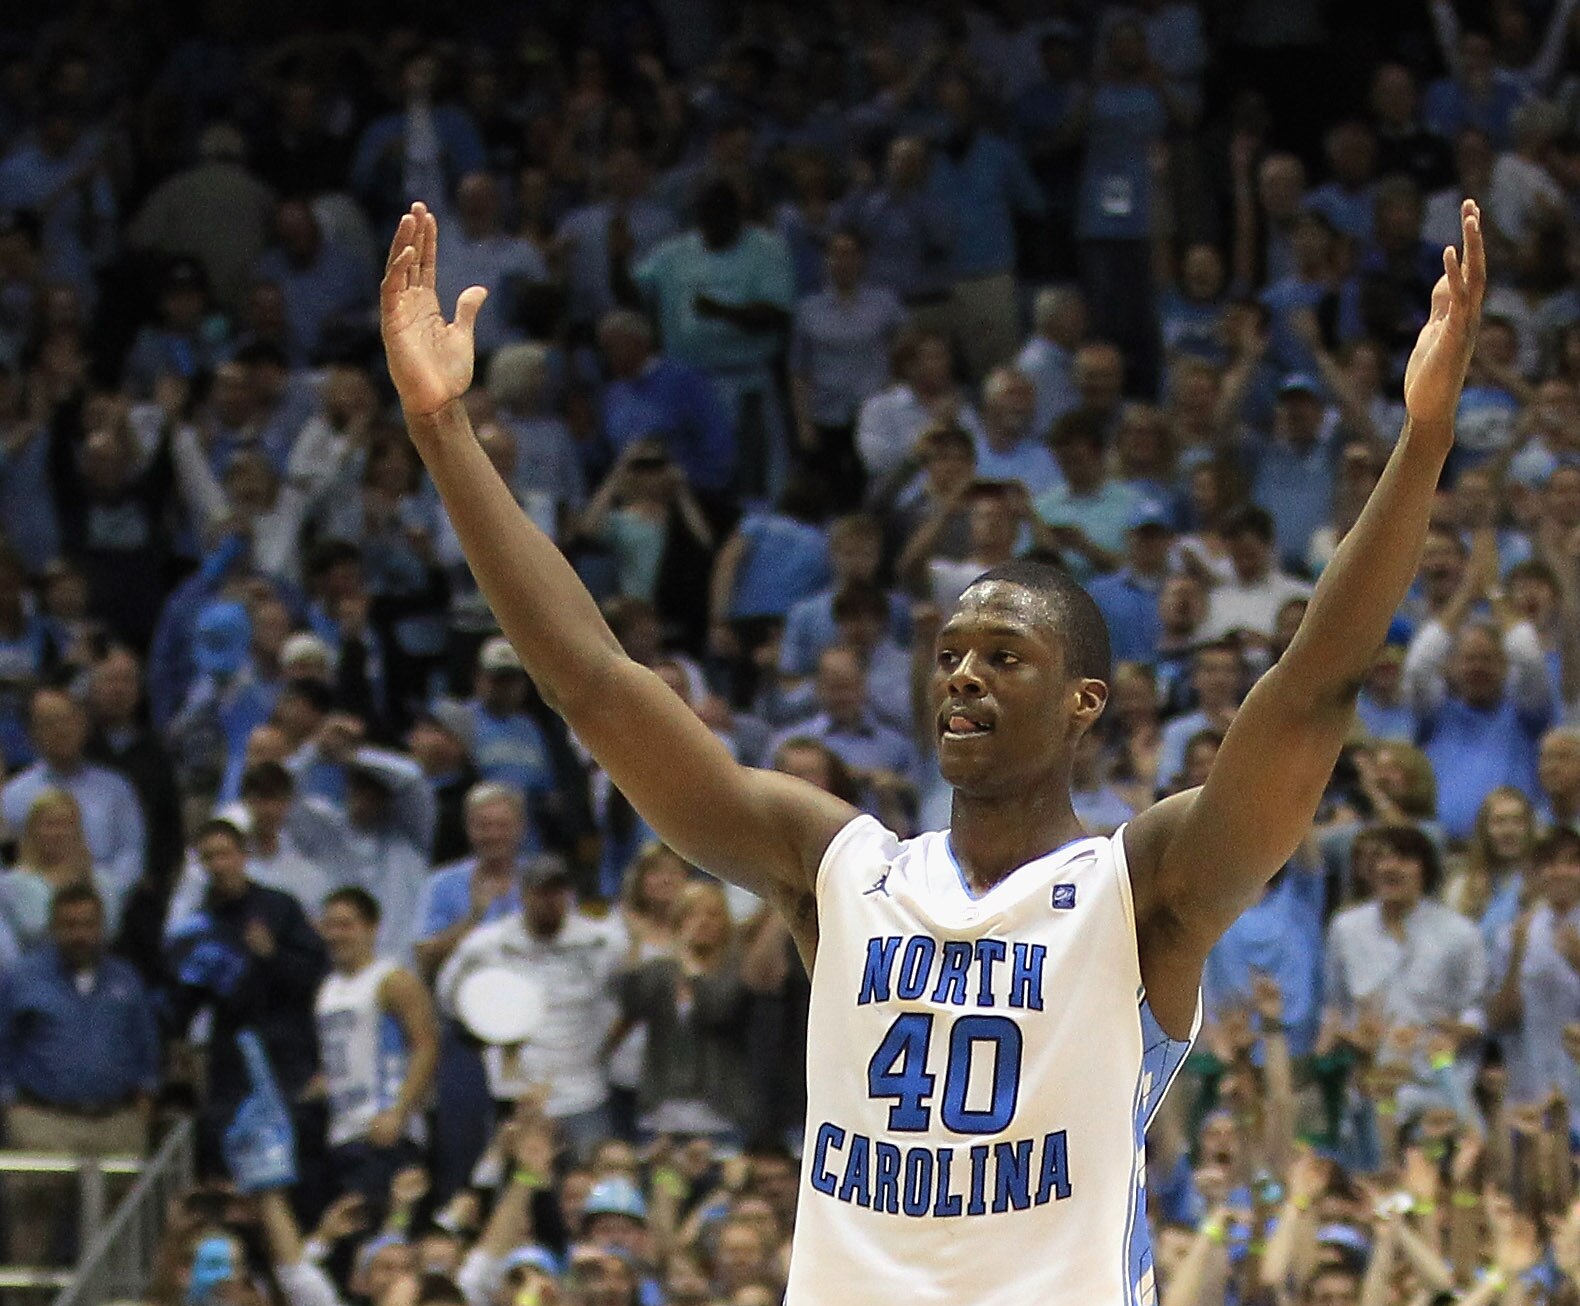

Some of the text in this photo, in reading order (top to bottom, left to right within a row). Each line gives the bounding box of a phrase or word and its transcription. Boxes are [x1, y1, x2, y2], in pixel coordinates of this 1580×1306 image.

[857, 935, 1047, 1011] NORTH
[867, 1012, 1023, 1135] 40
[811, 1122, 1072, 1218] CAROLINA
